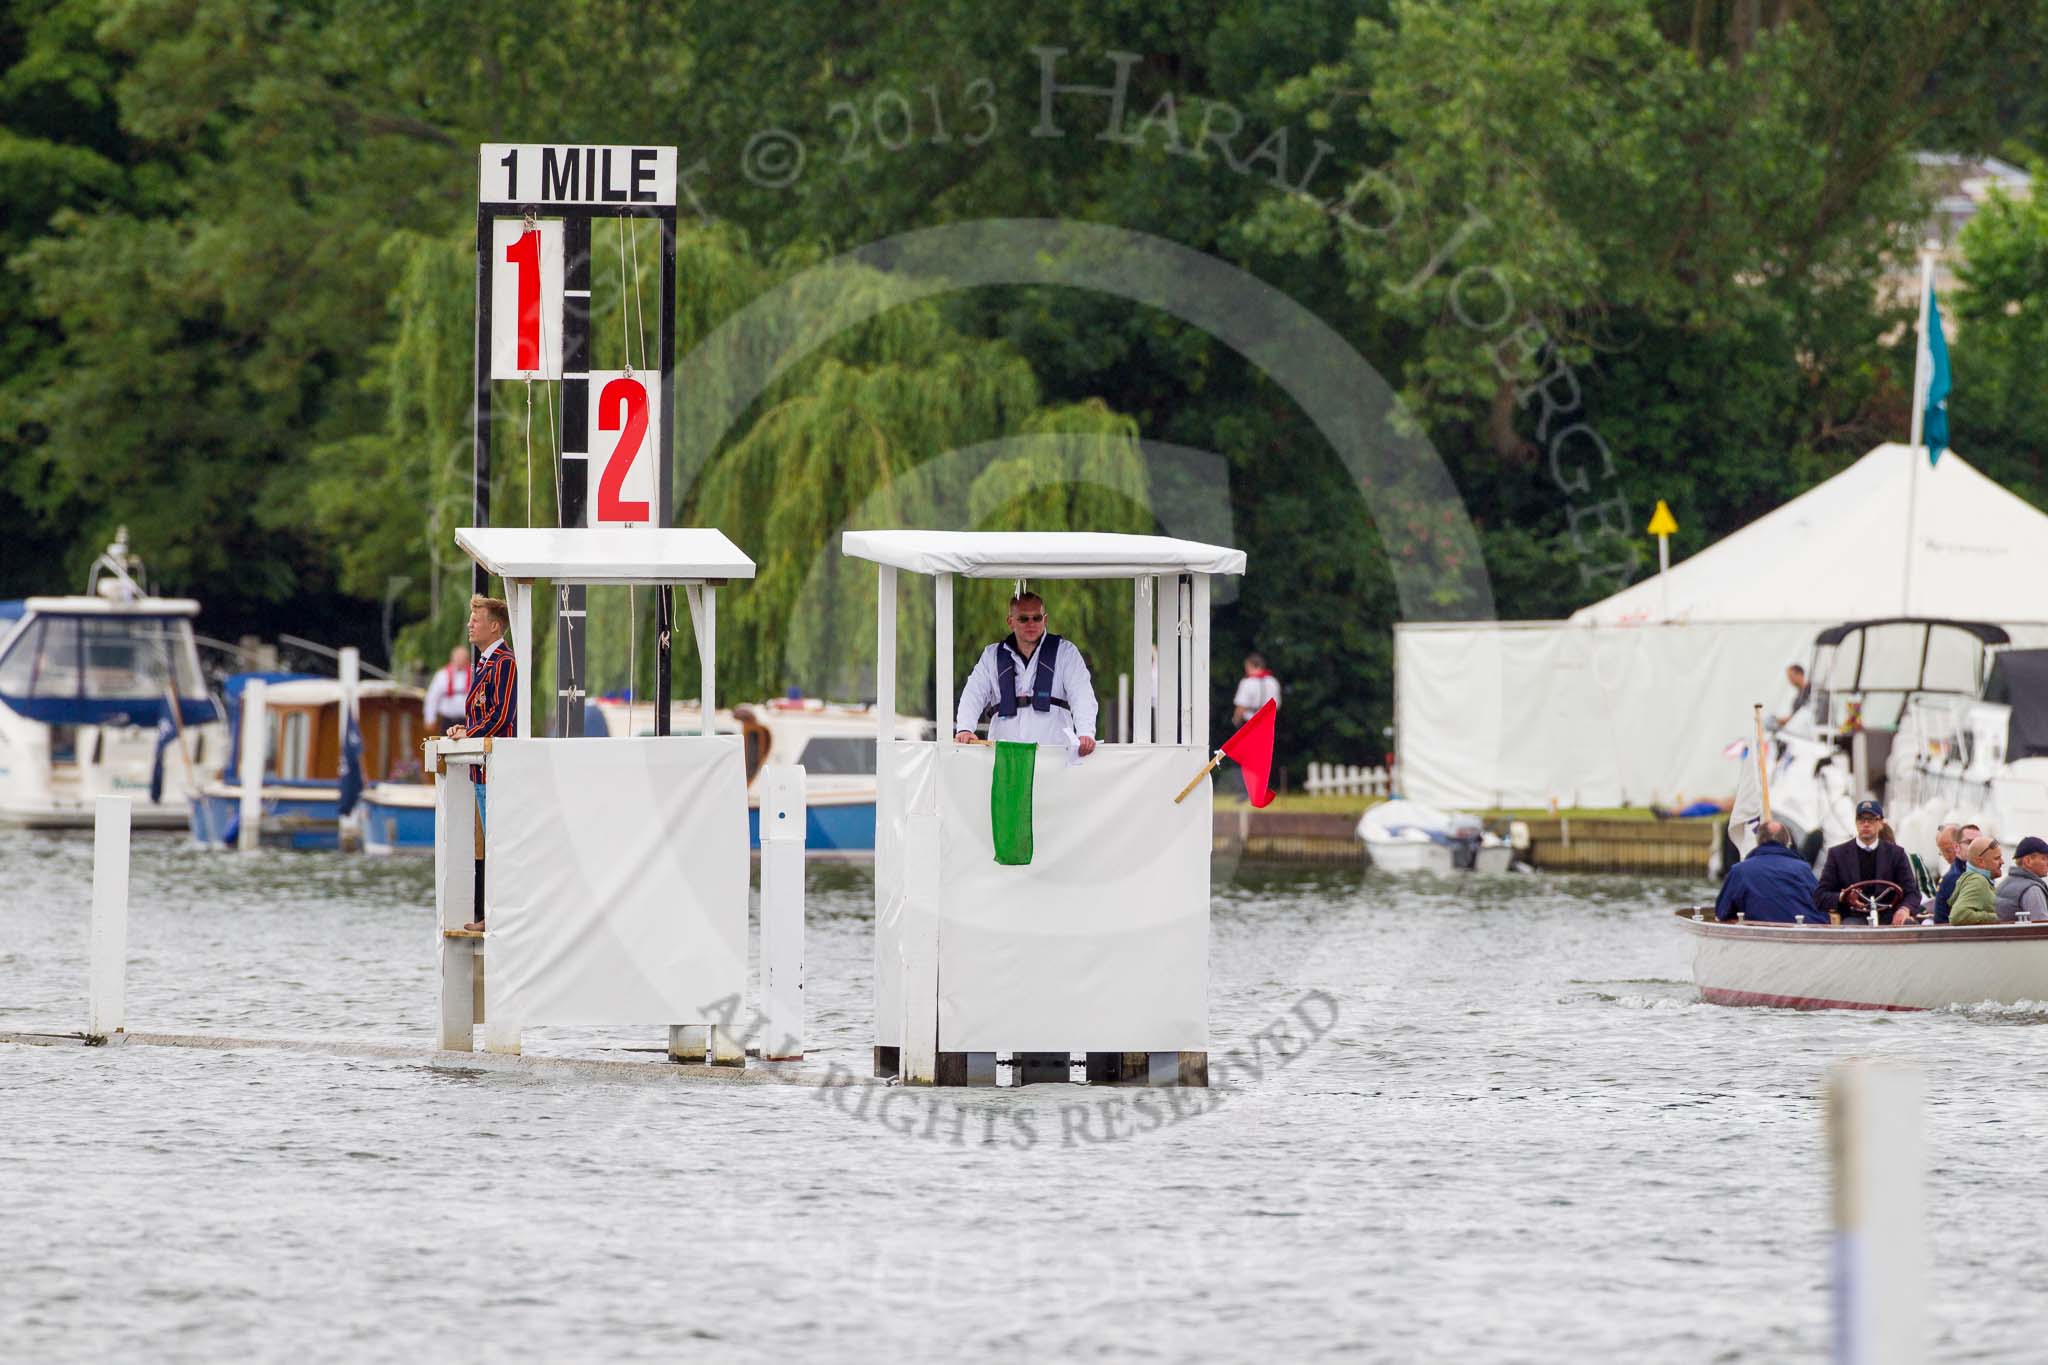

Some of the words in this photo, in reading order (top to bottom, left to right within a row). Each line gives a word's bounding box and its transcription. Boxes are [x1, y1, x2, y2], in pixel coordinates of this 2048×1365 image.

[501, 149, 518, 200] 1
[541, 147, 658, 202] MILE
[506, 230, 541, 371] 1
[598, 378, 650, 522] 2
